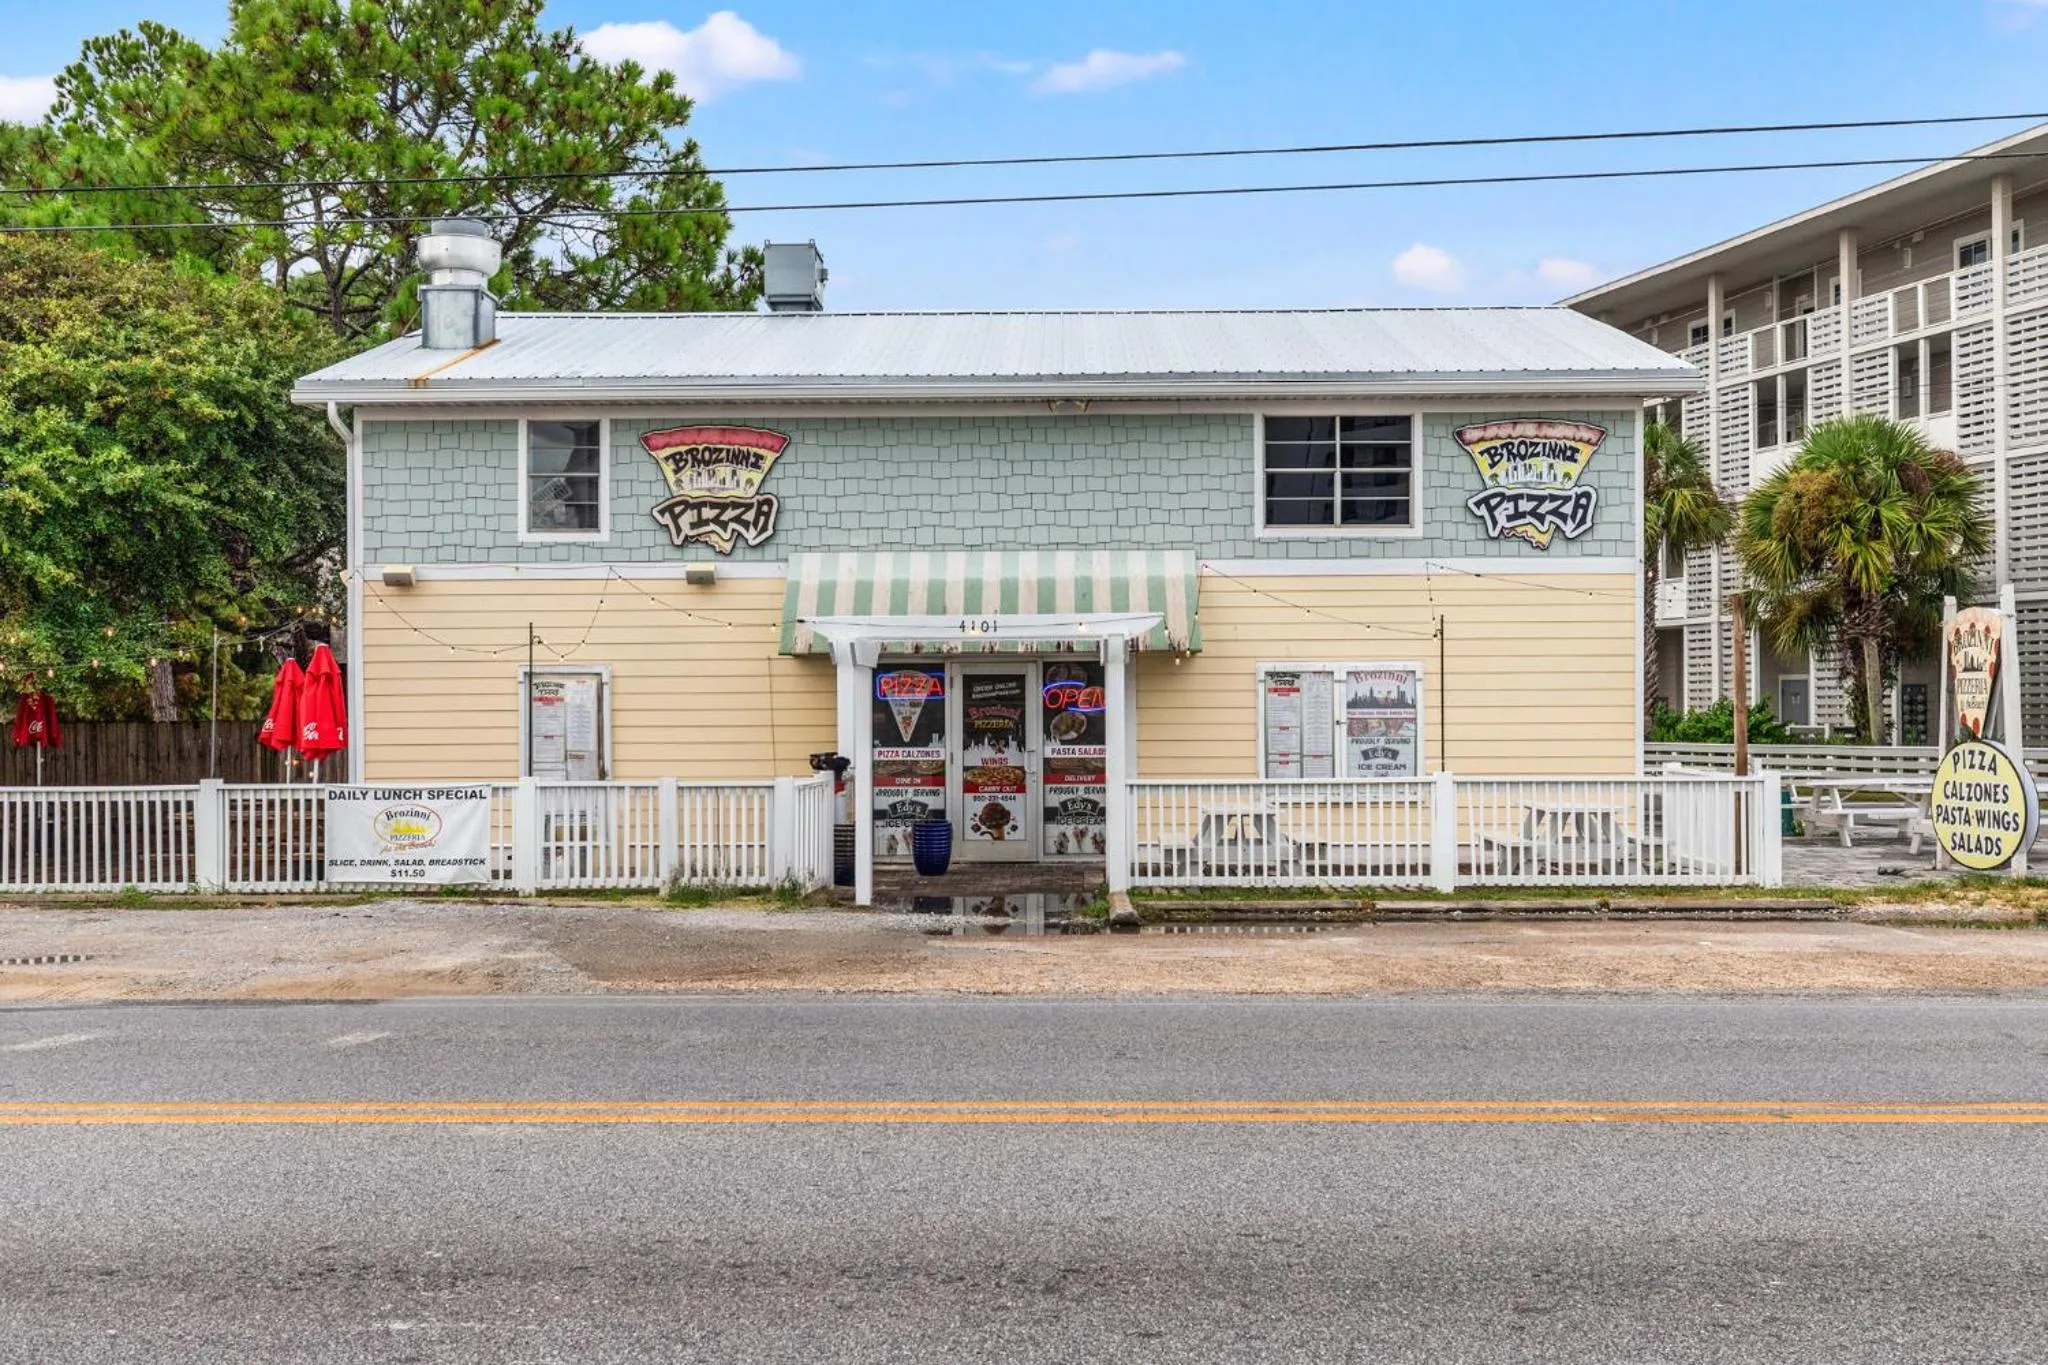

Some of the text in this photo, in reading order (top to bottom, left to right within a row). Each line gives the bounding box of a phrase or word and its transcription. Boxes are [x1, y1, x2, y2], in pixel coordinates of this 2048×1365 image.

[664, 447, 765, 475] BROZINNI
[1478, 441, 1582, 469] BROZINNI
[656, 499, 774, 541] PIZZA
[1473, 491, 1593, 535] PIZZA
[958, 620, 997, 632] 4101
[880, 676, 943, 697] PIZZA
[1956, 678, 1988, 695] PIZZERIA
[877, 750, 941, 758] PIZZA CALZONES
[981, 757, 1009, 765] WINGS
[1358, 763, 1407, 771] ICE CREAM
[1952, 749, 1998, 776] PIZZA
[328, 789, 487, 801] DAILY LUNCH SPECIAL
[979, 785, 1000, 793] CARRY
[1943, 780, 2009, 804] CALZONES
[385, 808, 432, 821] Brozinni
[1951, 832, 2001, 857] SALADS
[328, 859, 357, 867] SLICE,
[360, 859, 391, 867] DRINK,
[428, 858, 486, 867] BREADSTICK
[390, 869, 426, 878] $11.50
